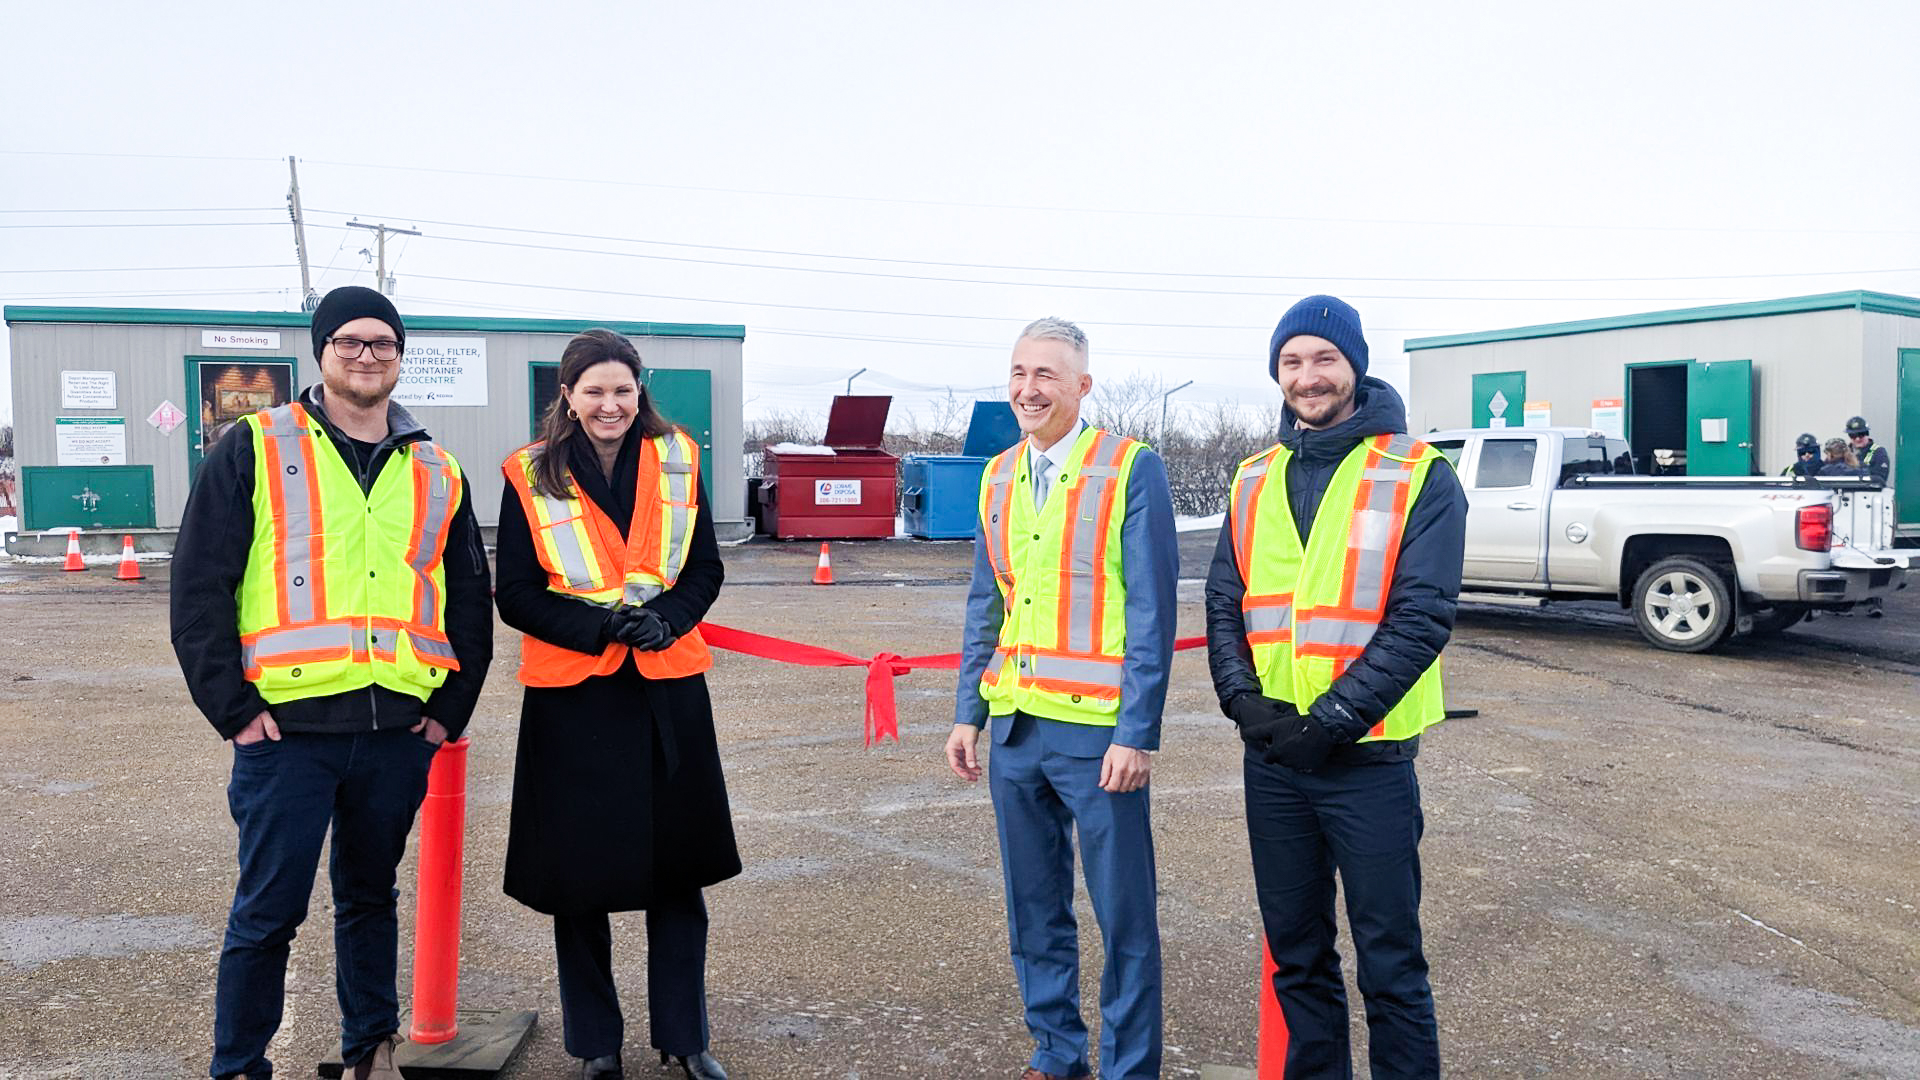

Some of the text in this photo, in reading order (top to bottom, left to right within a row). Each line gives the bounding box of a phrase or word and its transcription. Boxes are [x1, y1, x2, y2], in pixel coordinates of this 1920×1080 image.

[214, 335, 269, 346] No Smoking
[403, 347, 481, 358] SED OIL, FILTER,
[401, 357, 458, 365] ANTIFREEZE
[408, 366, 463, 375] CONTAINER
[399, 376, 456, 384] ECOCENTRE
